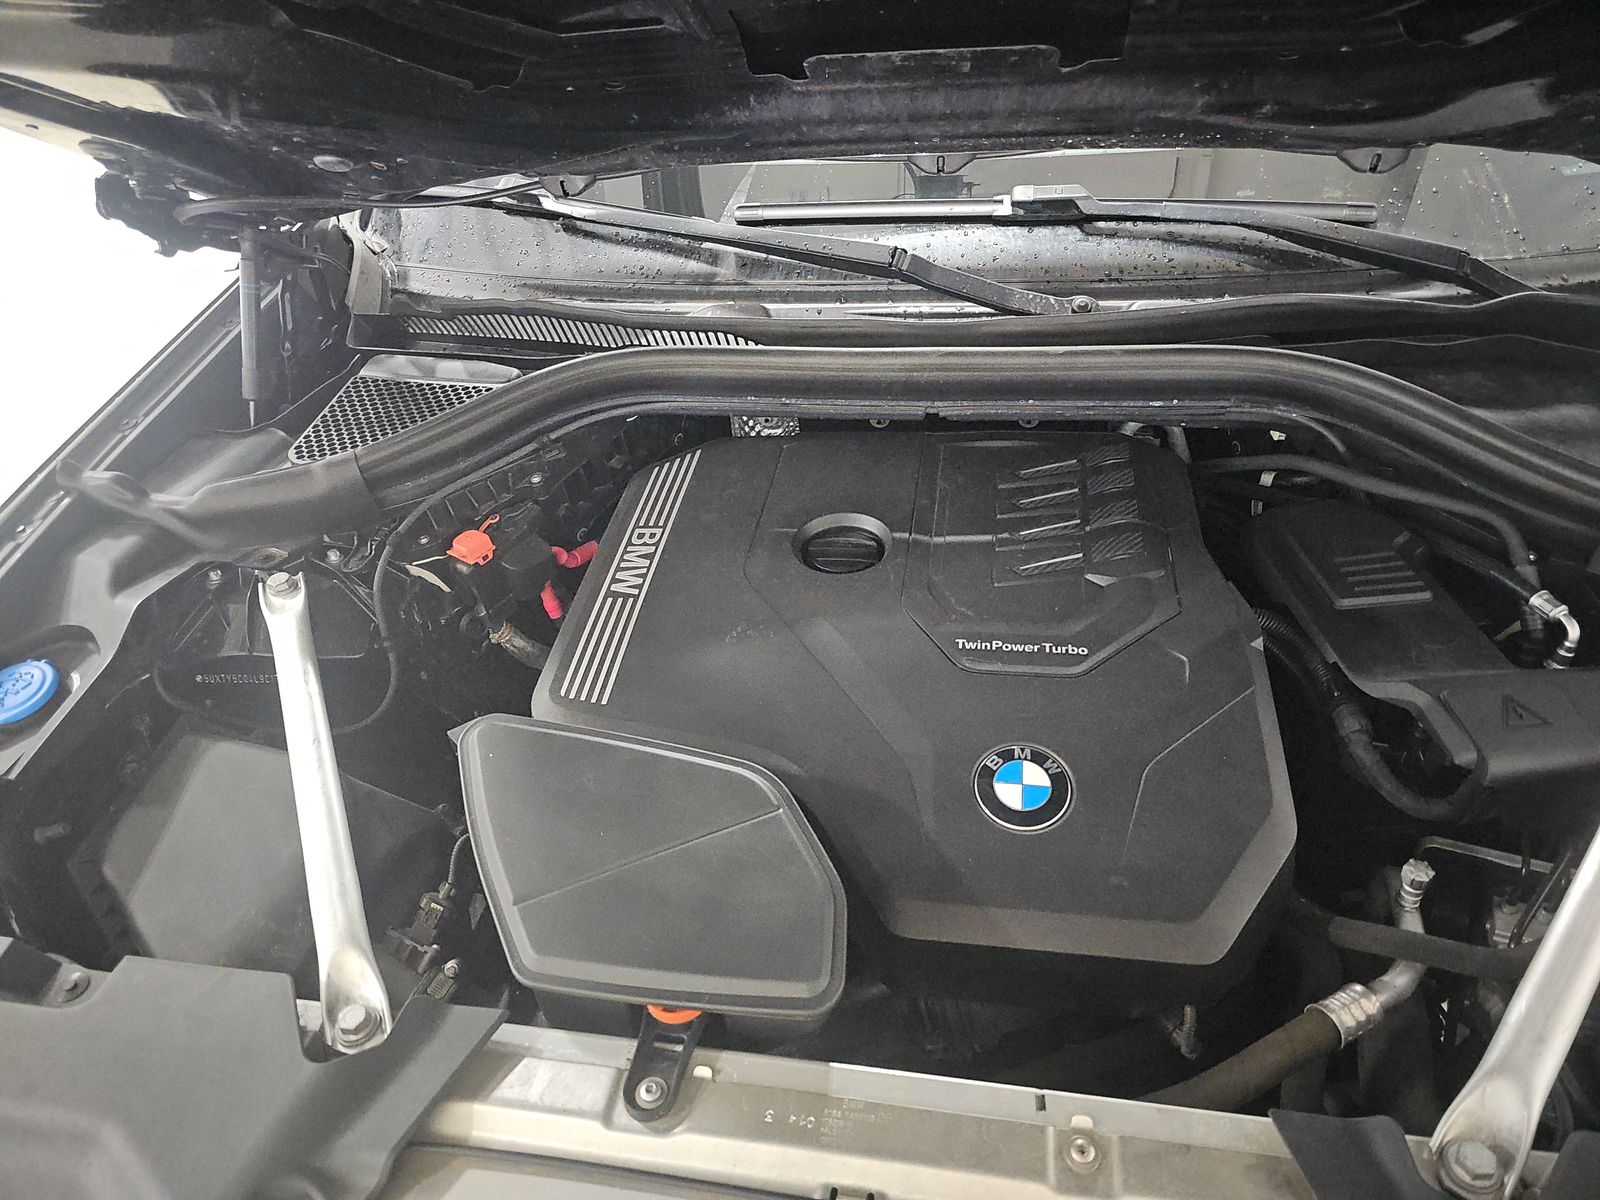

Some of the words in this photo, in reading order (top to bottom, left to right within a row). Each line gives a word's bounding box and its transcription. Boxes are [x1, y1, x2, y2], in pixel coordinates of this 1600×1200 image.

[610, 527, 664, 595] BMW
[955, 638, 1040, 653] TwinPower
[1042, 642, 1089, 656] Turbo
[985, 747, 1062, 775] BMW
